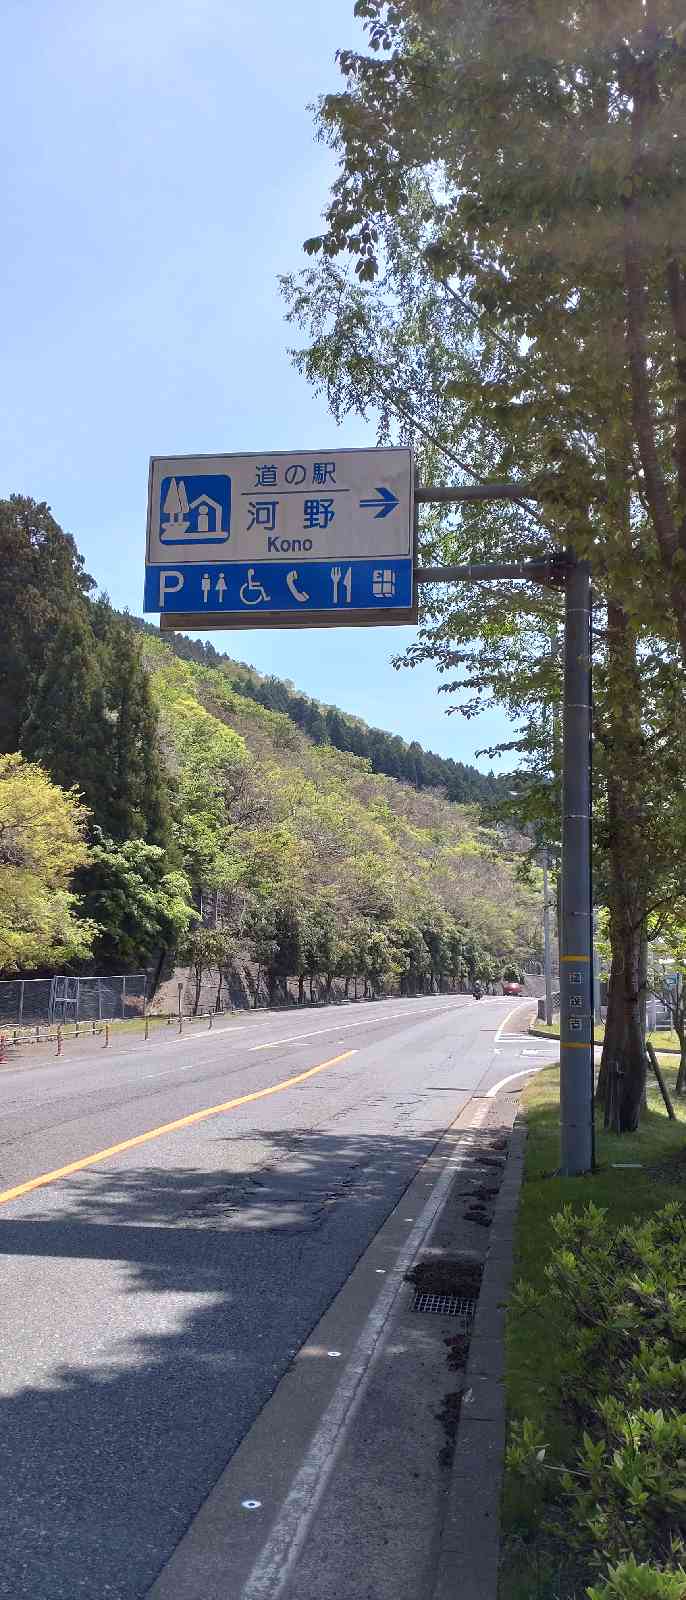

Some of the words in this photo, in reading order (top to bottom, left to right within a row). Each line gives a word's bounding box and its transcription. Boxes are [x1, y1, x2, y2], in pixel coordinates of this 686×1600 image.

[254, 462, 336, 488] 道の駅
[247, 498, 336, 531] 河野
[267, 536, 313, 553] Kono
[159, 570, 185, 608] P
